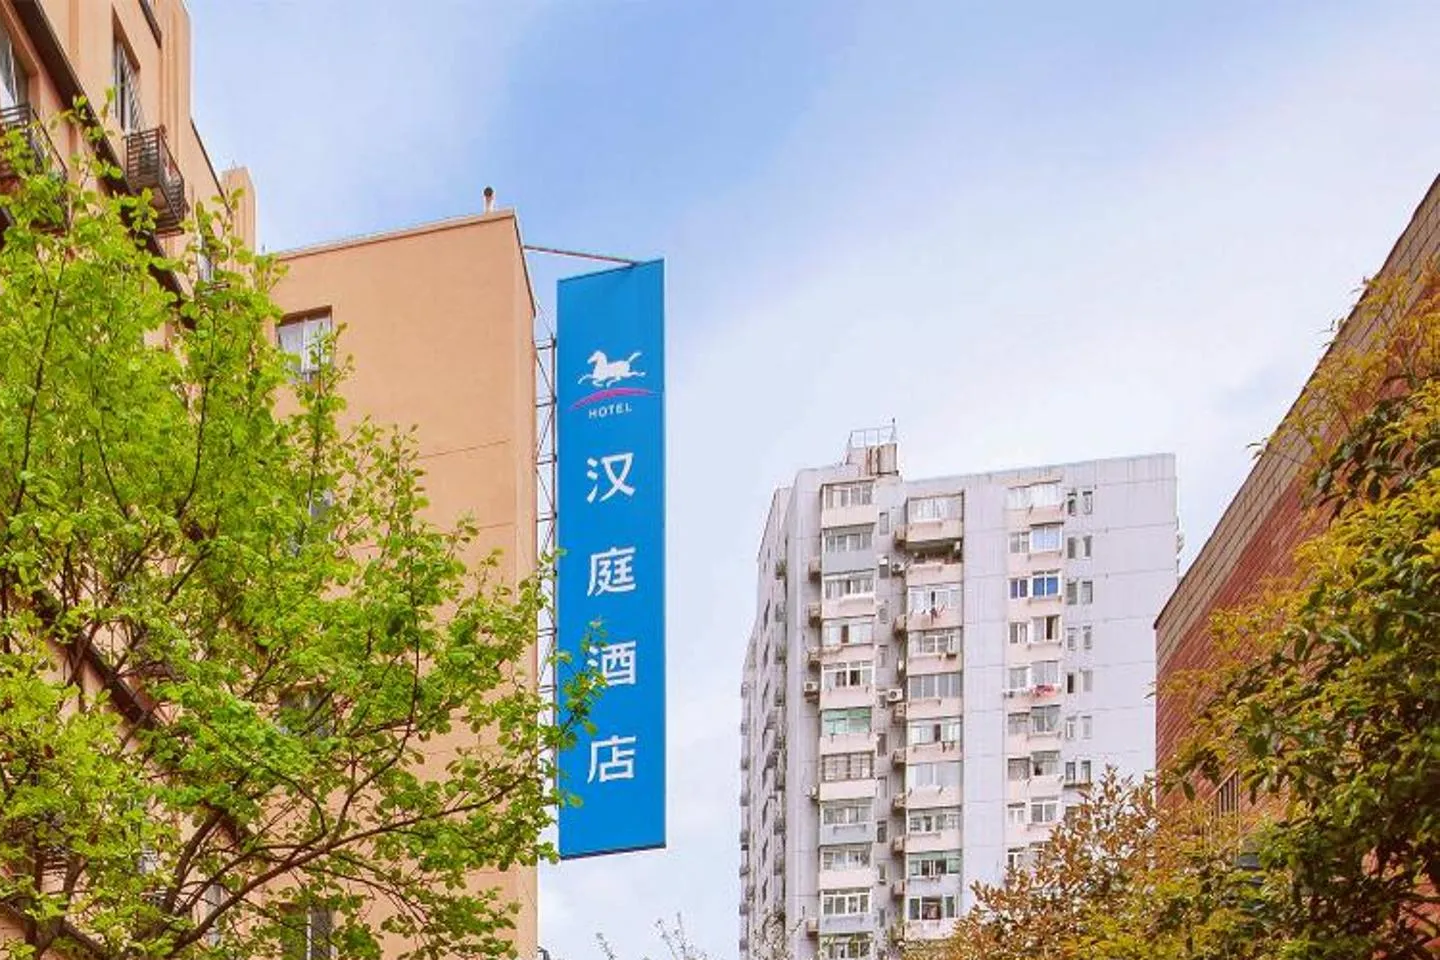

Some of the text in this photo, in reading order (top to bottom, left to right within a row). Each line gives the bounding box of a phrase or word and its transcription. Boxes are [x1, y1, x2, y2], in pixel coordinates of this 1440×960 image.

[588, 401, 633, 420] HOTEL
[586, 450, 637, 785] 汉庭酒店
